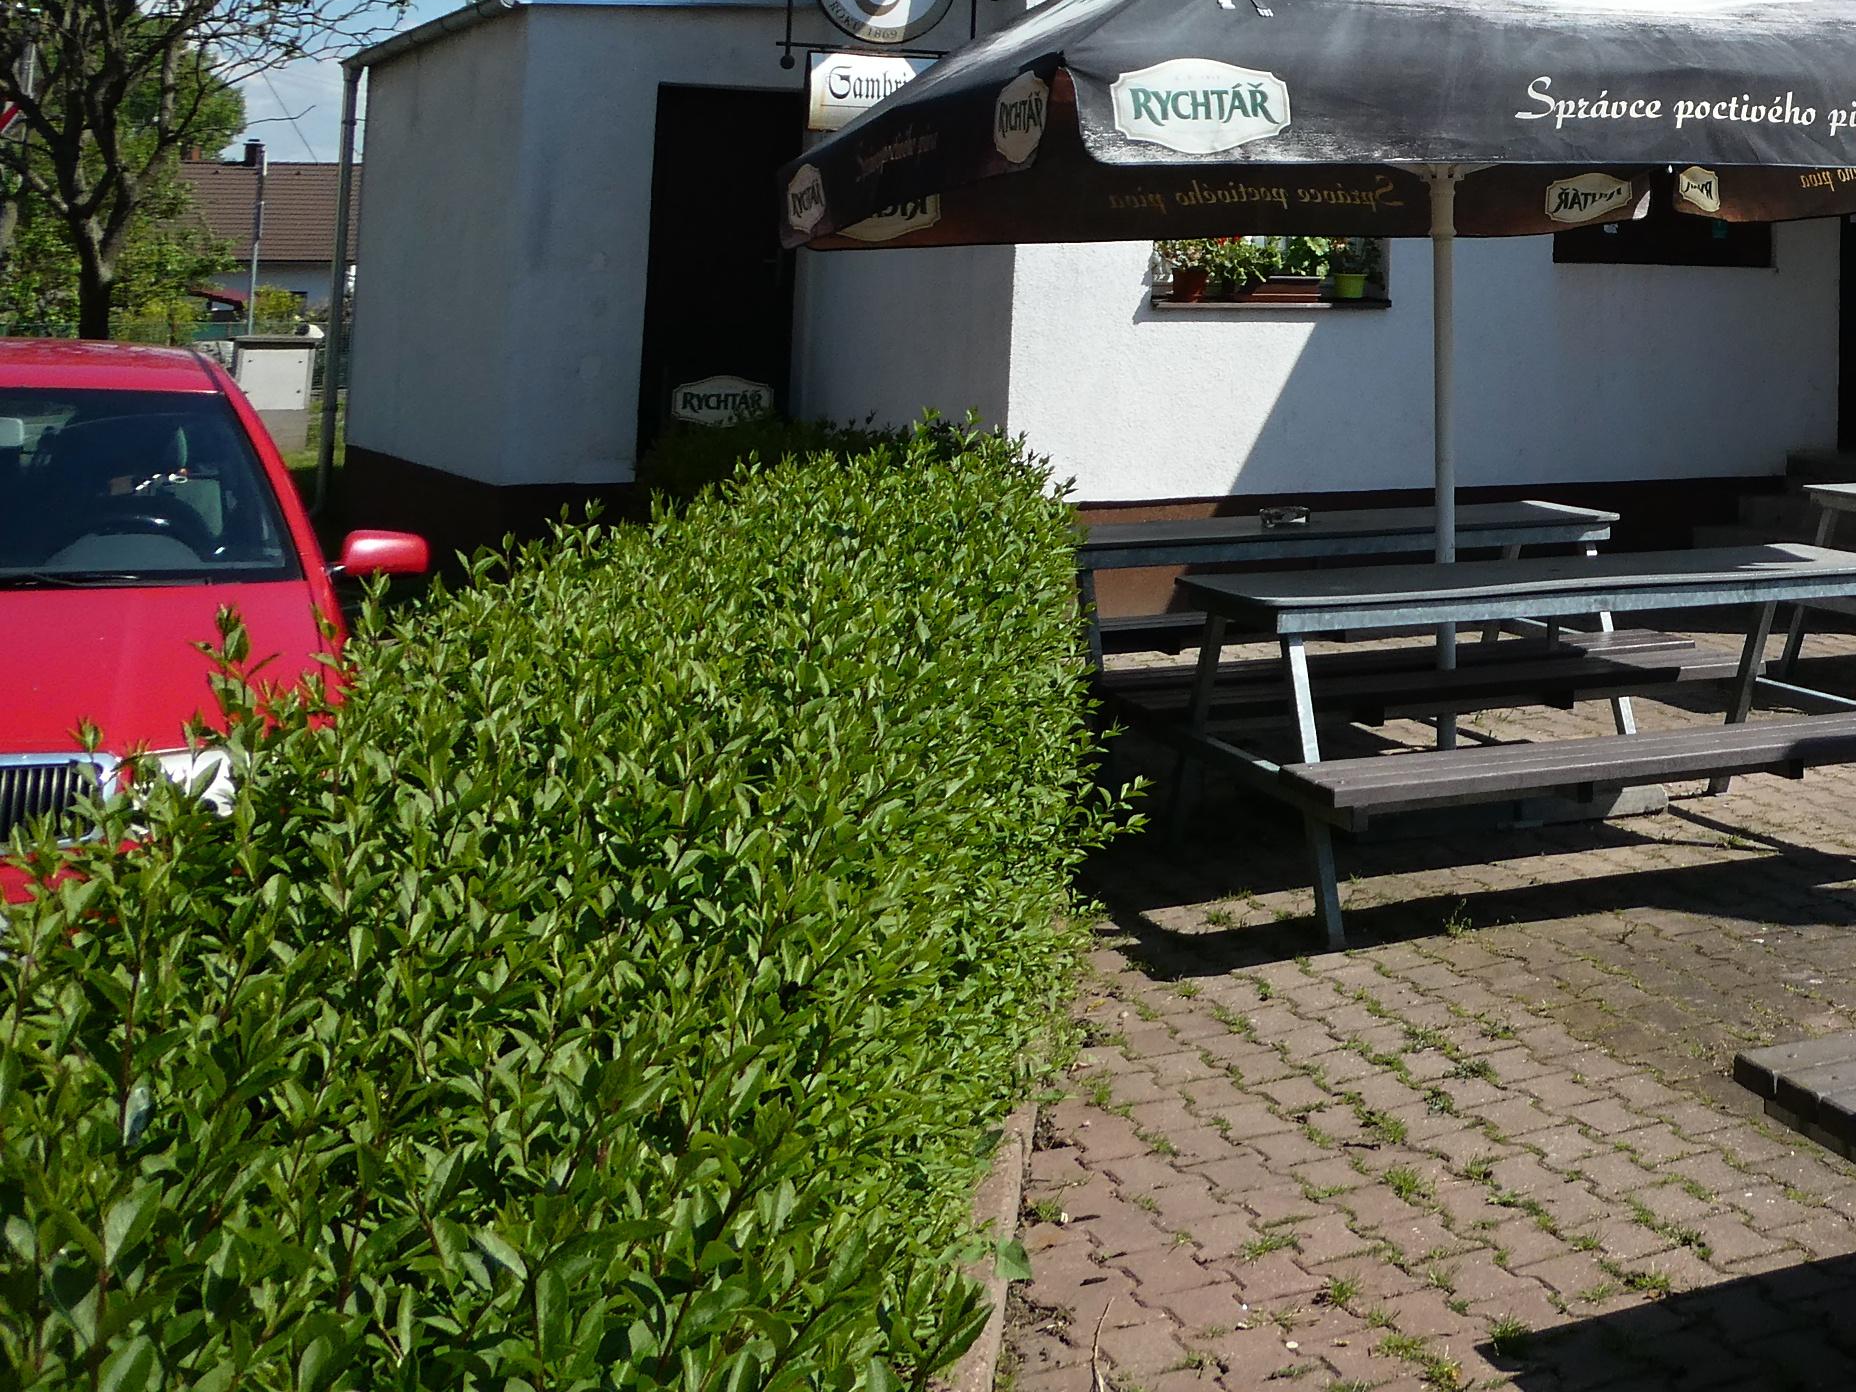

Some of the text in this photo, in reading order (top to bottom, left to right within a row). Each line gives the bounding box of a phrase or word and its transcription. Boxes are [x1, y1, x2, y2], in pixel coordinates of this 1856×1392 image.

[825, 65, 908, 100] Gambri
[1129, 82, 1280, 127] RYCHTÁŘ
[1515, 76, 1662, 129] Správce
[1673, 91, 1816, 129] poctivého
